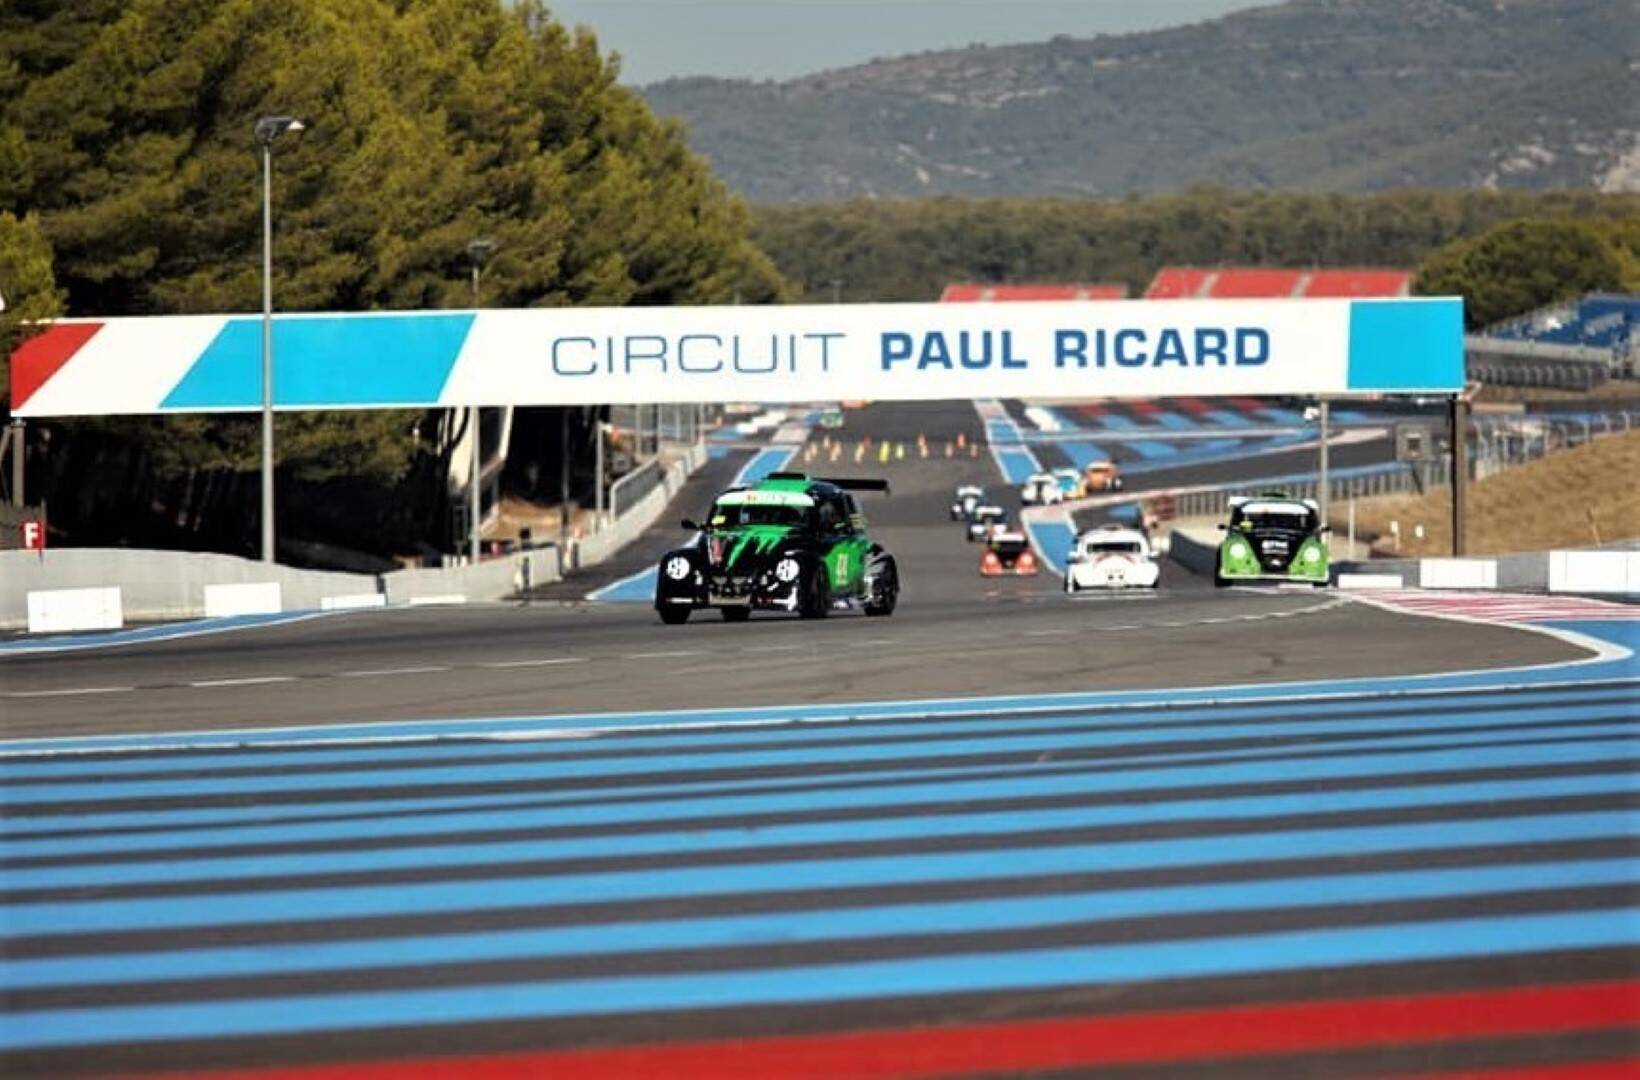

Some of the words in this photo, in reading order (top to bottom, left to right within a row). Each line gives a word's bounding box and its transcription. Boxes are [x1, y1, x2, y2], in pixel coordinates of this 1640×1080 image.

[551, 333, 846, 375] CIRCUIT
[881, 330, 1028, 371] PAUL
[1054, 327, 1271, 368] RICARD
[25, 522, 39, 547] F
